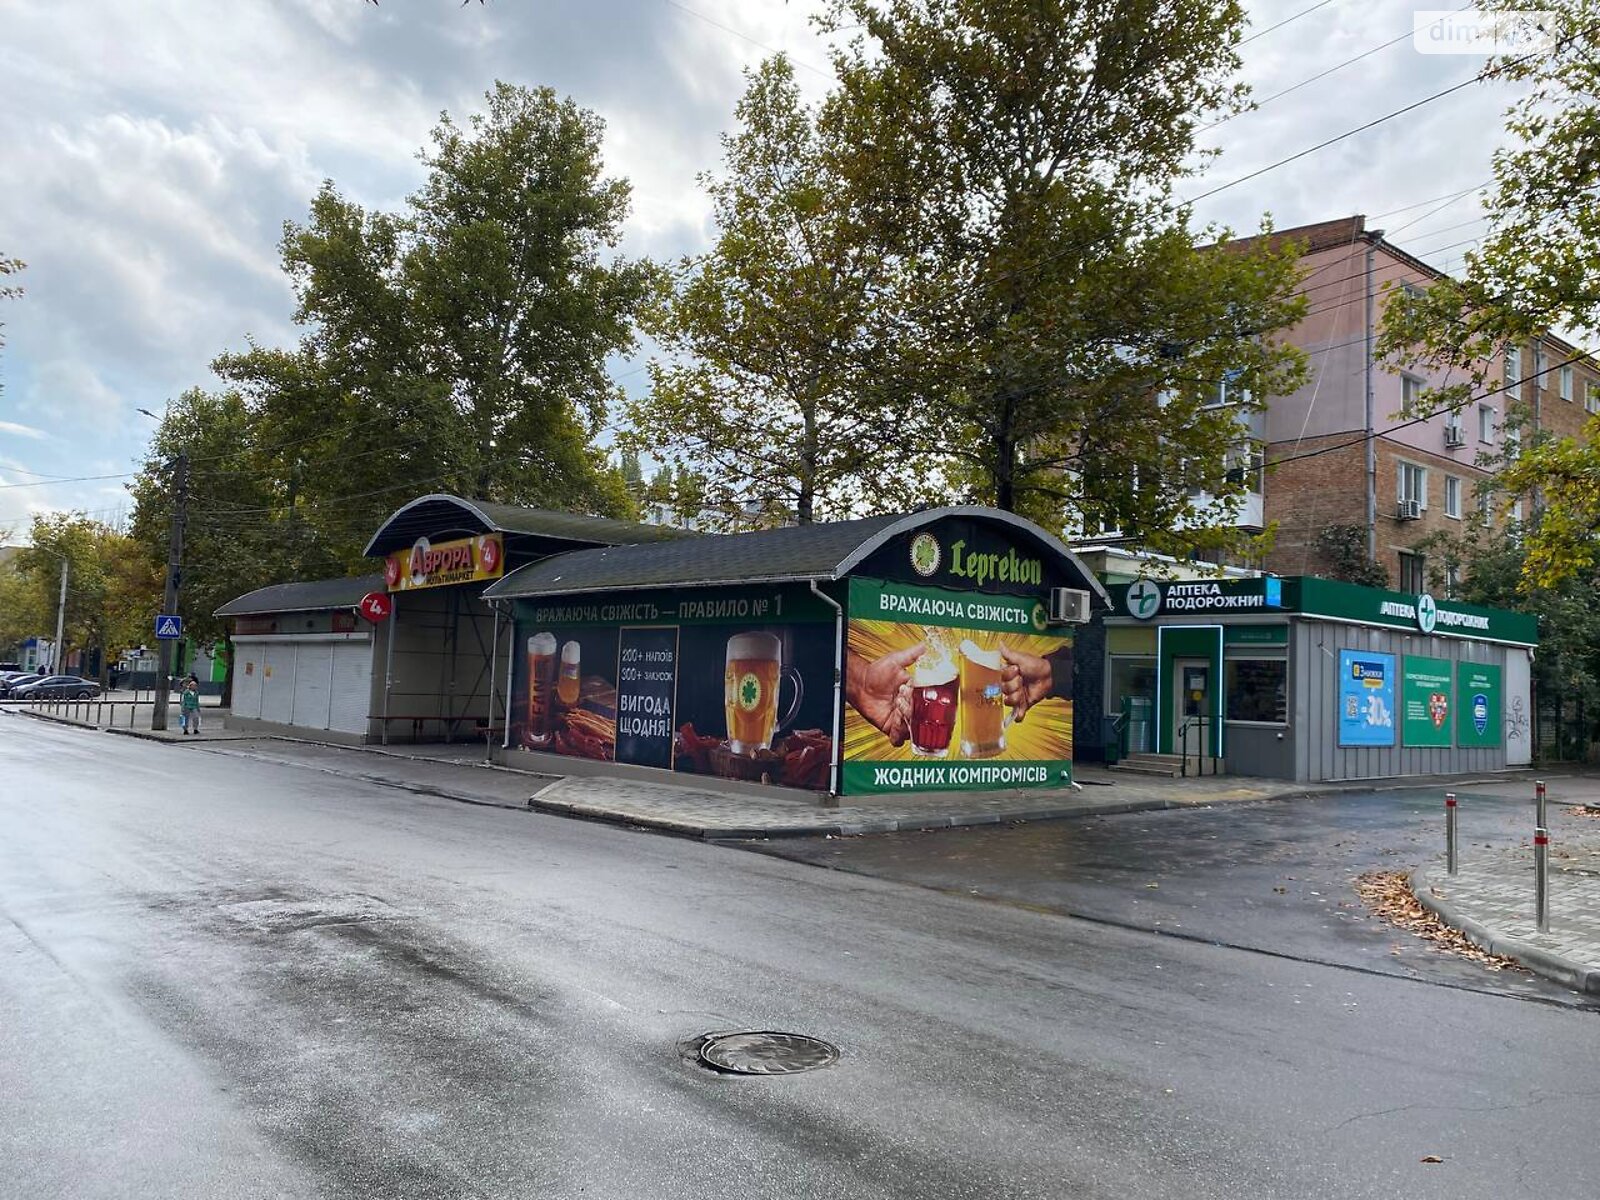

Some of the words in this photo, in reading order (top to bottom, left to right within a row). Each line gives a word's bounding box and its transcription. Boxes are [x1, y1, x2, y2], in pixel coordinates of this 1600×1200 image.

[411, 545, 472, 575] АВРОРА
[949, 540, 1043, 586] Leprekon
[1166, 583, 1222, 597] АПТЕКА
[535, 605, 598, 622] ВРАЖАЮЧА
[601, 603, 659, 621] СВІЖІСТЬ
[679, 600, 749, 619] ПРАВИЛО
[775, 594, 783, 616] 1
[880, 594, 965, 619] ВРАЖАЮЧА
[967, 606, 1029, 625] СВІЖІСТЬ
[1379, 601, 1417, 619] АПТЕКА
[622, 648, 643, 662] 200+
[621, 667, 642, 681] 300+
[620, 694, 671, 716] ВИГОДА
[619, 716, 671, 738] ЩОДНЯ!
[873, 767, 946, 787] ЖОДНИХ
[949, 766, 1047, 785] КОМПРОМІСІВ
